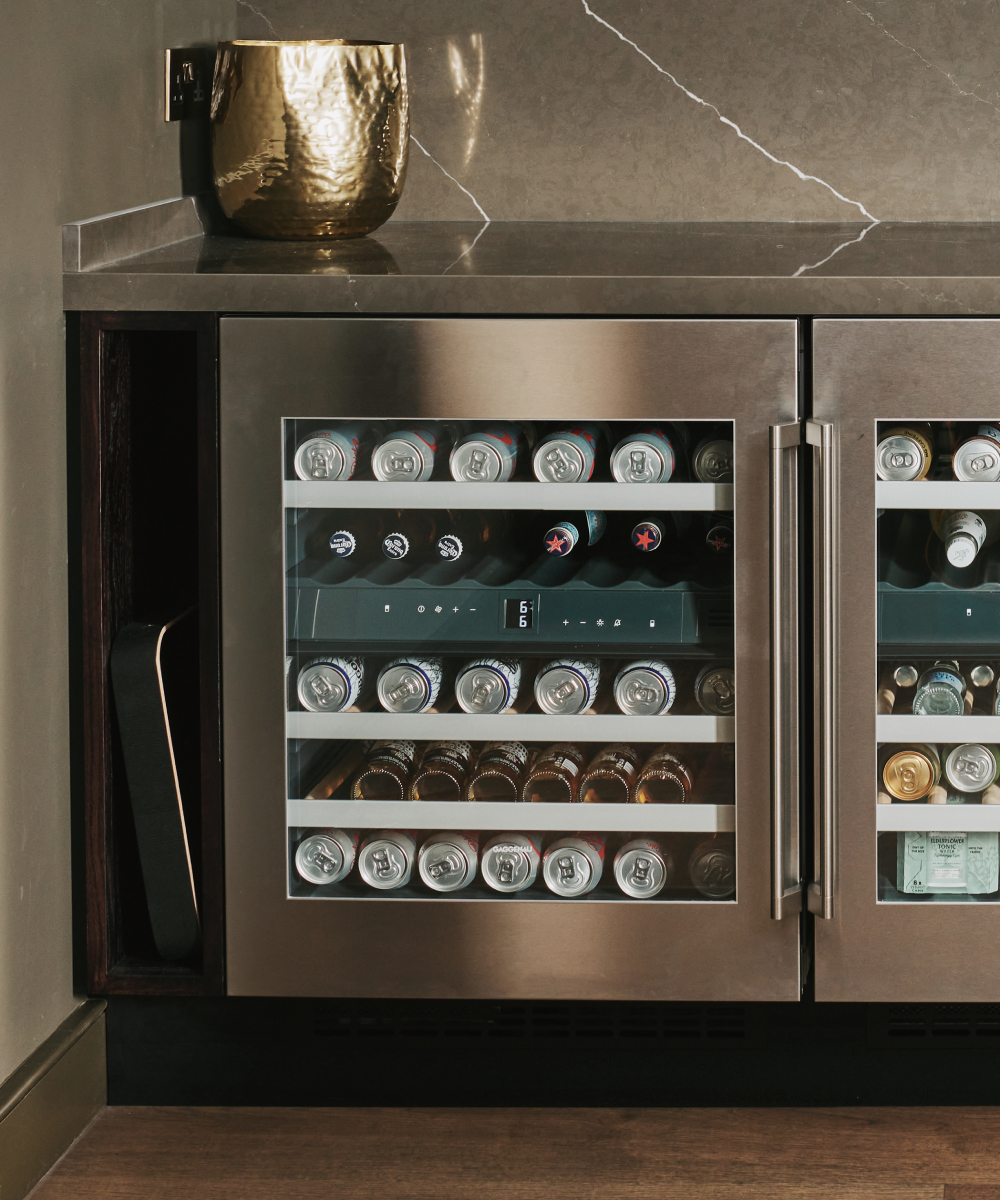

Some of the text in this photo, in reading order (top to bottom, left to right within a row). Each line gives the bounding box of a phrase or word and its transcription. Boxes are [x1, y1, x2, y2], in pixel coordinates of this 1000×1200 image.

[330, 540, 352, 549] Corona
[384, 539, 403, 555] Corona
[438, 542, 458, 556] Corona
[520, 601, 528, 614] 6
[519, 615, 528, 628] 6
[492, 845, 534, 853] GAGGENAU
